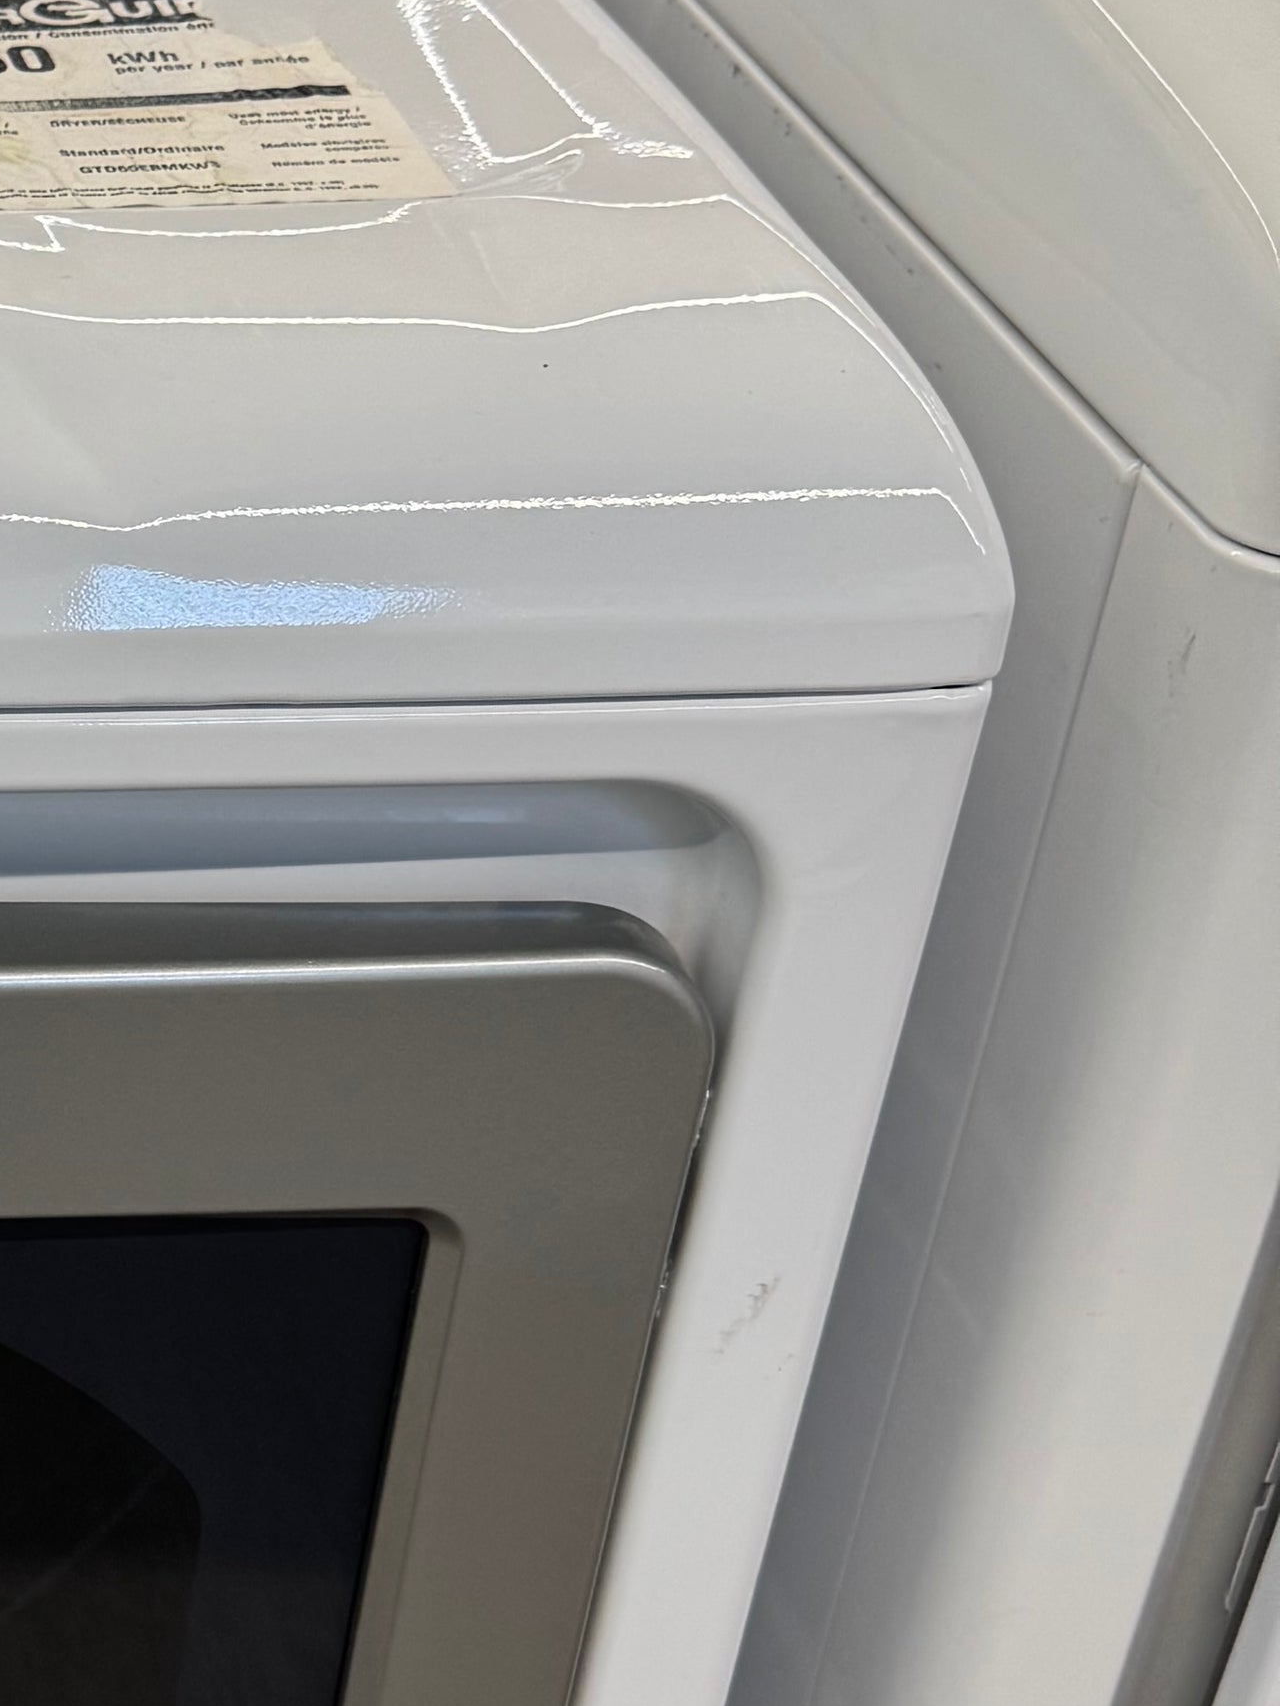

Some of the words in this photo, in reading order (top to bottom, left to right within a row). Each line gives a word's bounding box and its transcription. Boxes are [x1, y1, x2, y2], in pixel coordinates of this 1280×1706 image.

[47, 23, 180, 40] Consommation
[106, 49, 180, 66] kWh
[114, 65, 147, 76] per
[152, 62, 194, 74] year
